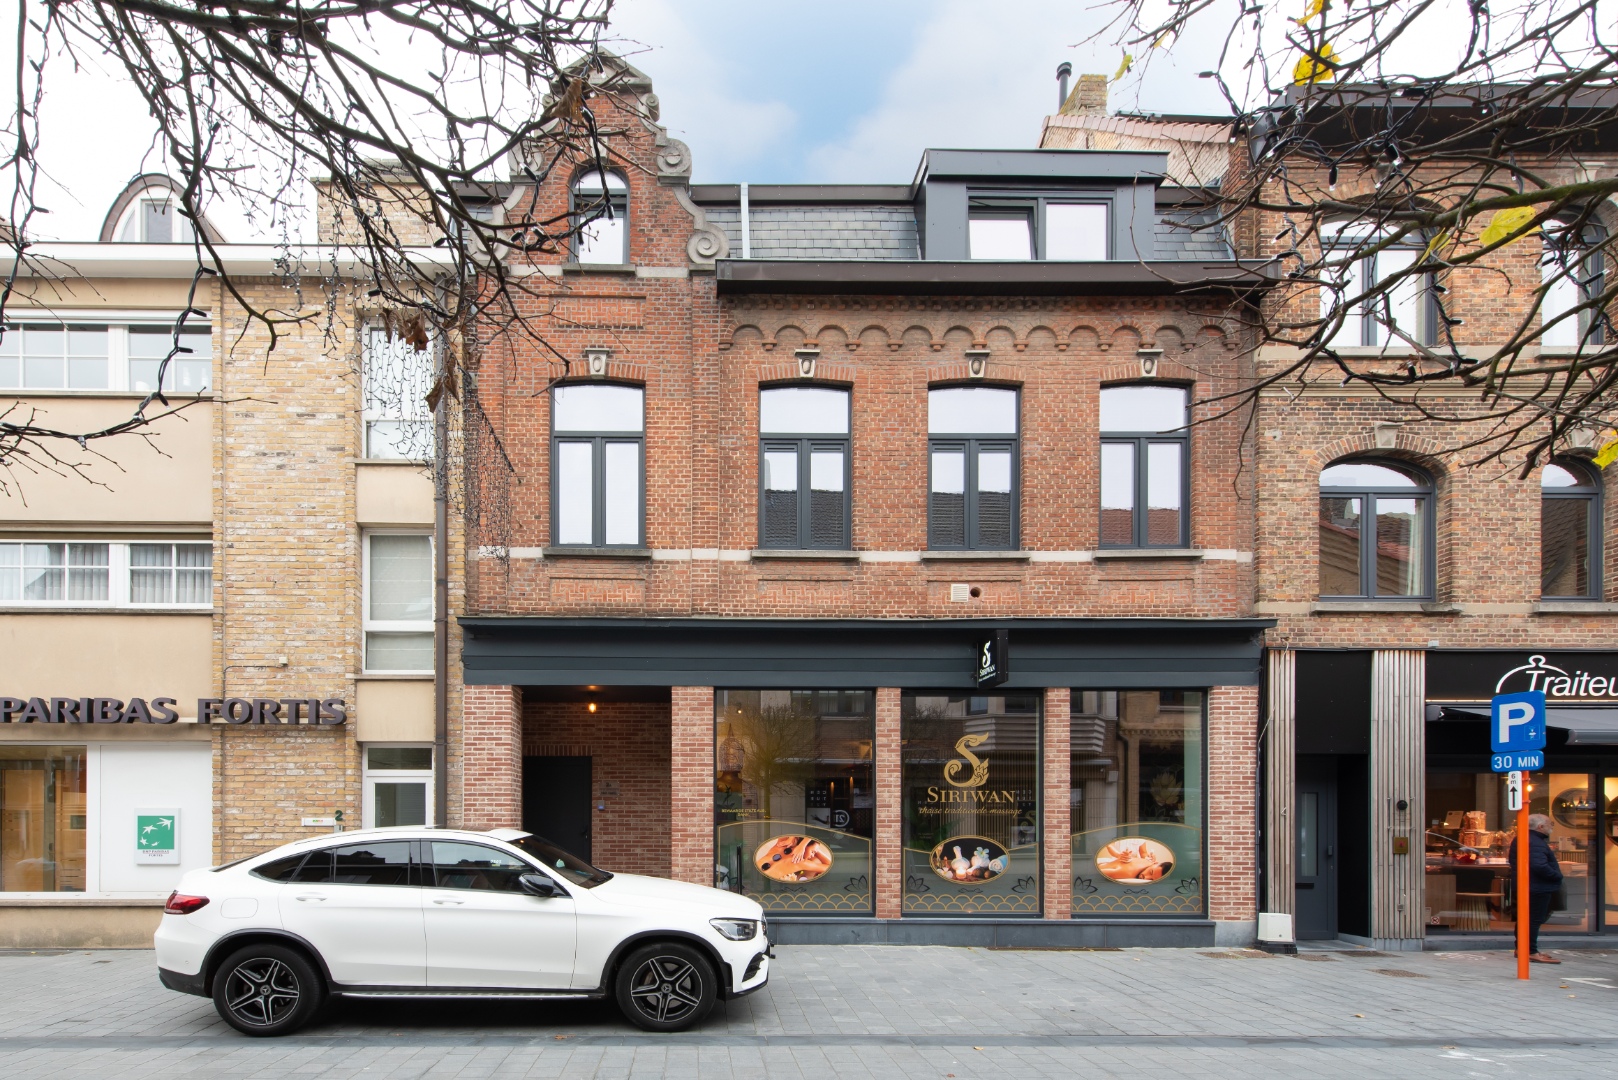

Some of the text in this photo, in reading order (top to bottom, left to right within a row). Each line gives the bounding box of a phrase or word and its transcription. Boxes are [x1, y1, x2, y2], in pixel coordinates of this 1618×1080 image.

[0, 697, 347, 725] PARIBAS FORTIS
[1498, 701, 1535, 744] P
[1494, 755, 1539, 769] 30 MIN
[927, 786, 1015, 803] SIRIWAN
[334, 809, 344, 821] 2
[919, 806, 941, 814] thaise
